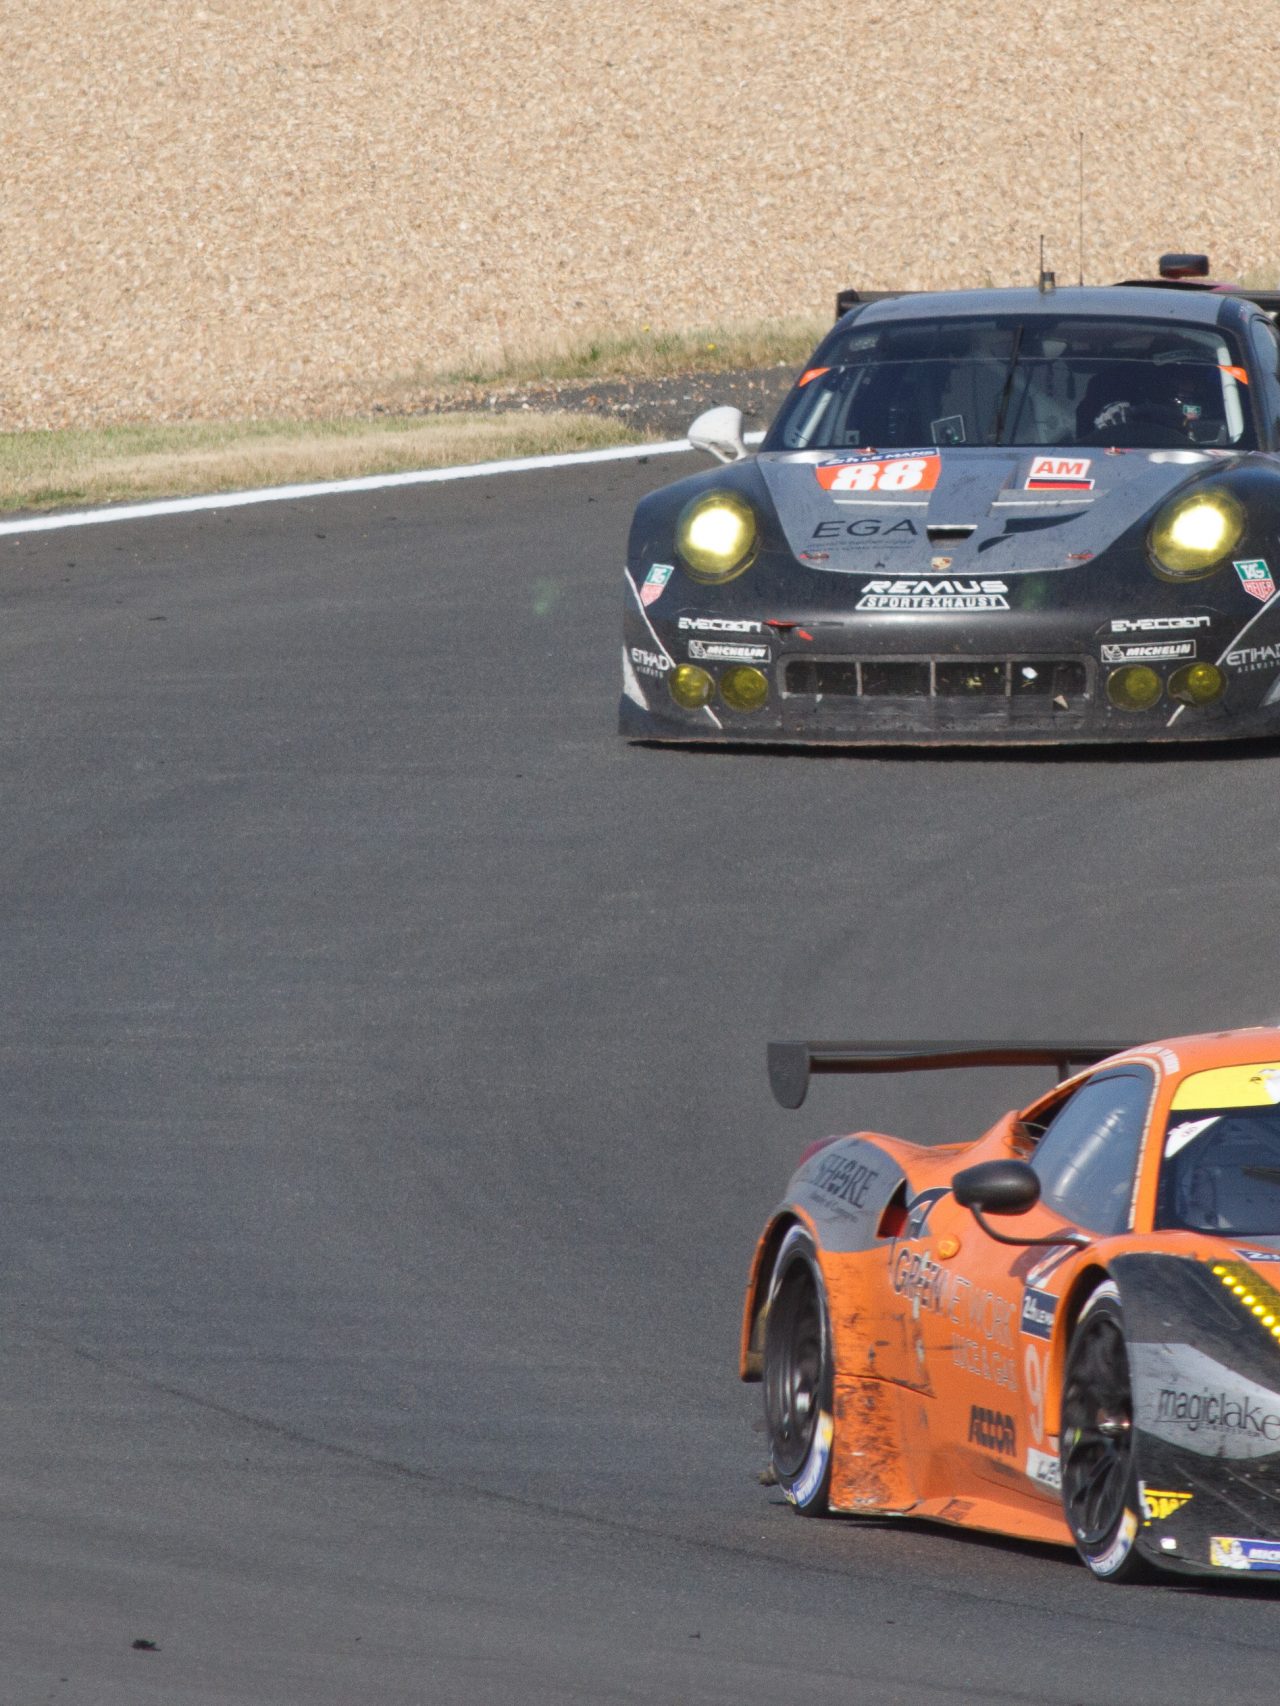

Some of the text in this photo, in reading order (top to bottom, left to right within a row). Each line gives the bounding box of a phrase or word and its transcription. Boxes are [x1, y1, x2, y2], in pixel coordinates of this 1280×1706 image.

[885, 450, 936, 458] MANS
[830, 459, 928, 491] 88
[1035, 460, 1084, 475] AM
[811, 518, 919, 539] EGA
[1240, 563, 1265, 580] TAG
[861, 580, 1009, 595] REMUS
[866, 596, 998, 609] SPORTEXHAUST
[706, 645, 767, 658] MICHELIN
[1126, 643, 1192, 658] MICHELIN
[630, 647, 671, 671] ETIHAD
